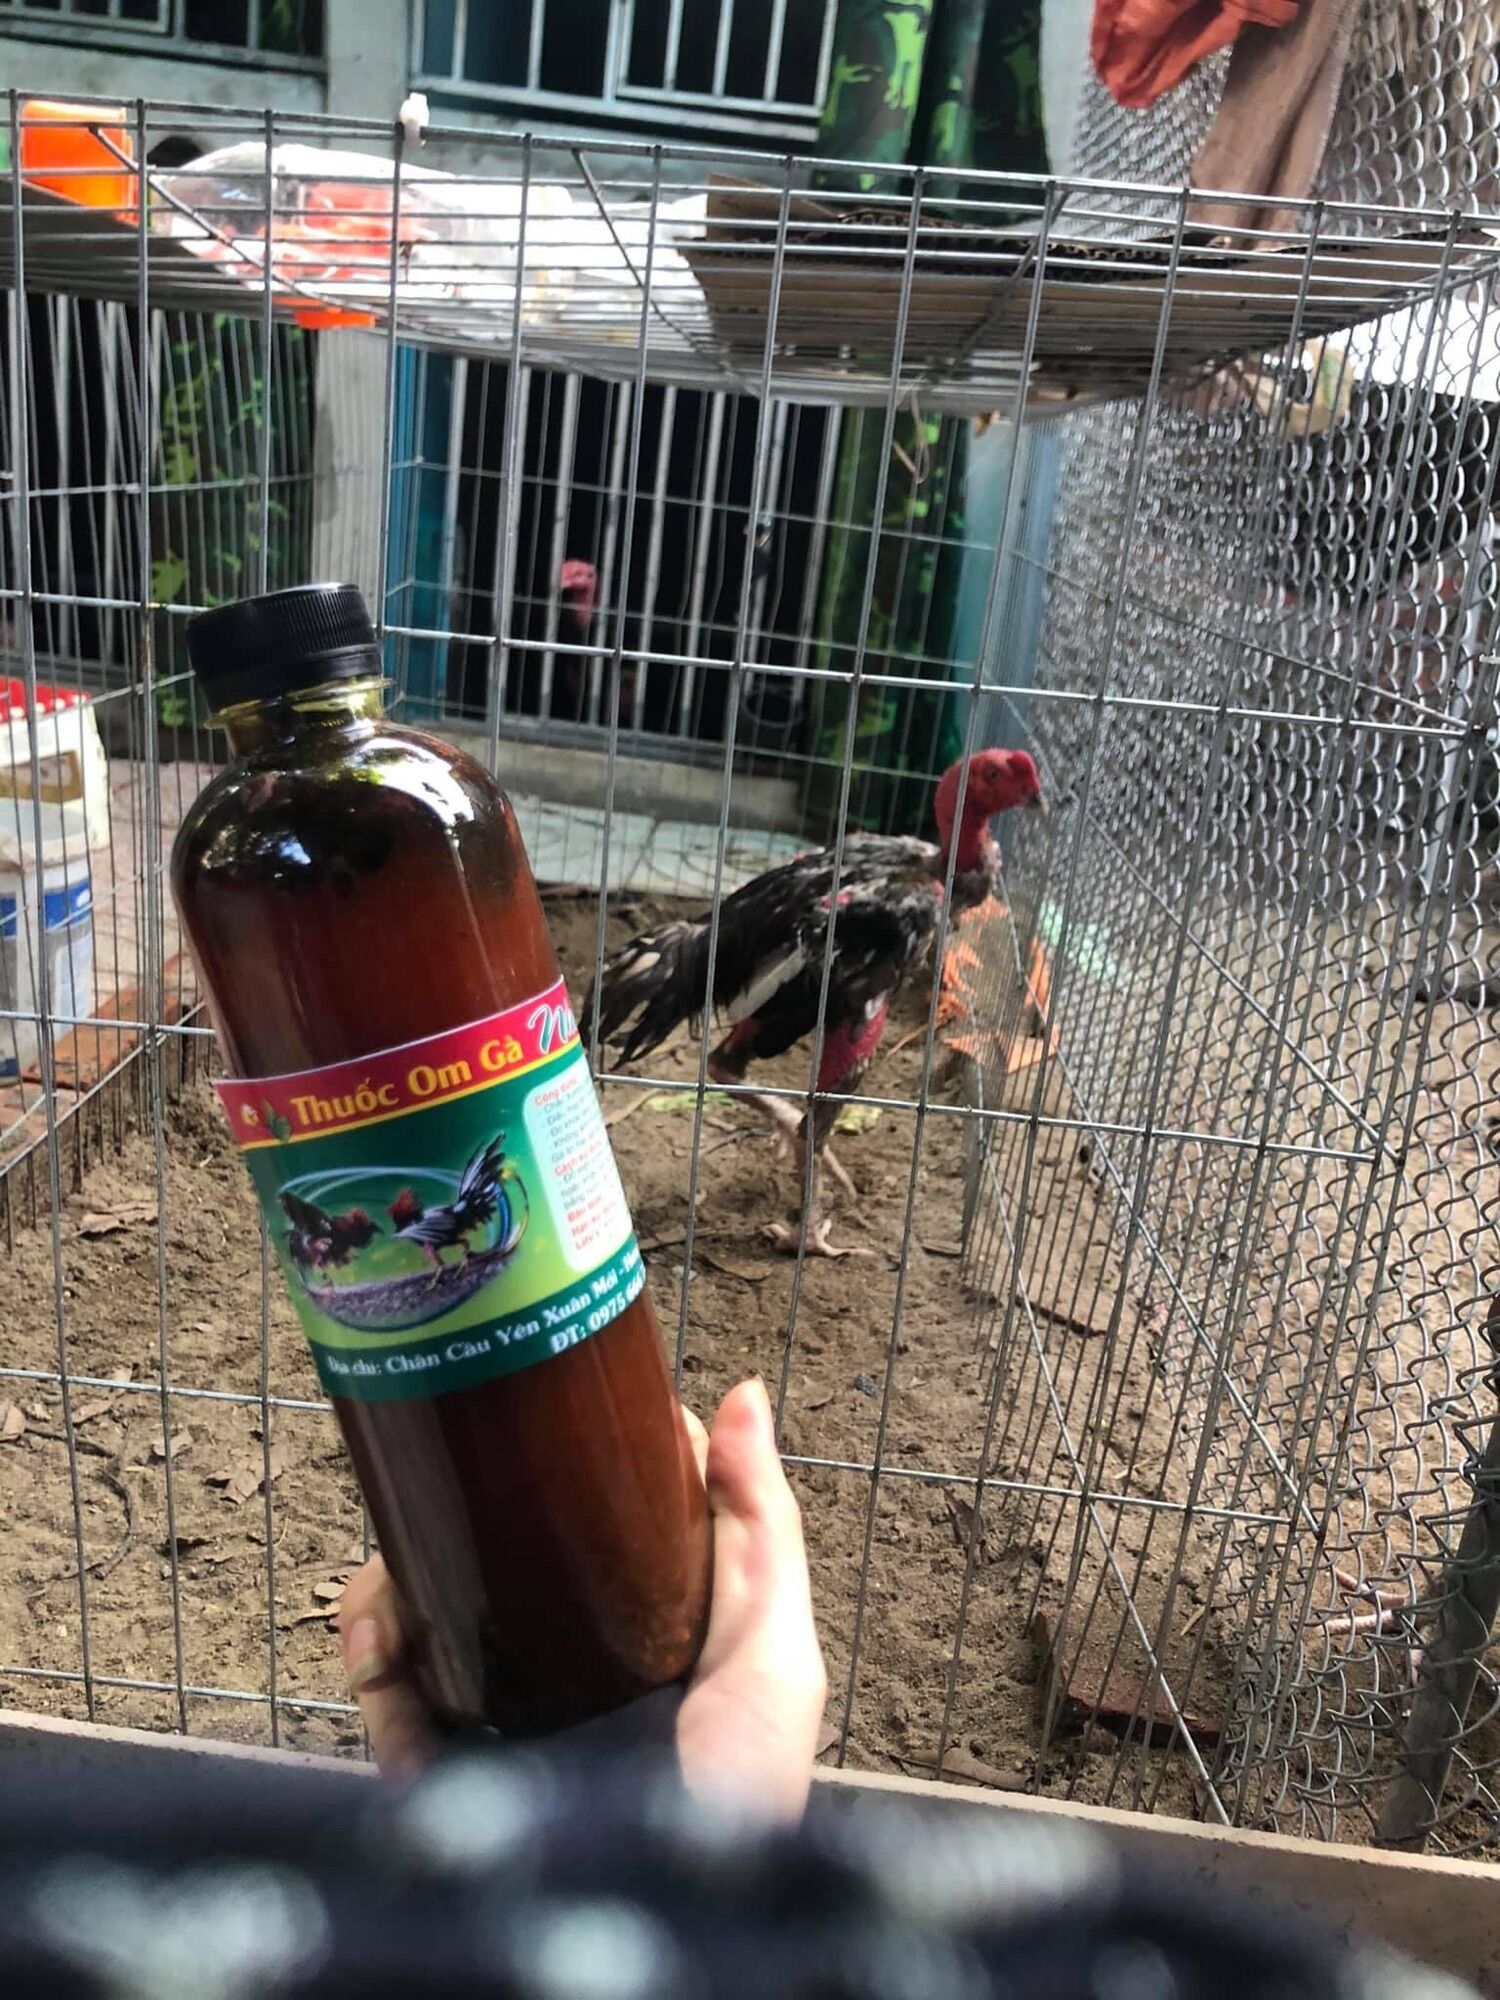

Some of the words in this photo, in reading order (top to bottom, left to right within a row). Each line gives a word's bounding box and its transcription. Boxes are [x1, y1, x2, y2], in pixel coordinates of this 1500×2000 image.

[290, 1078, 399, 1126] Thuốc
[408, 1059, 472, 1096] Om
[479, 1035, 524, 1072] Gà
[385, 1352, 441, 1374] Chân
[495, 1319, 541, 1346] Yên
[541, 1292, 592, 1327] Xuân
[589, 1291, 627, 1333] 0975
